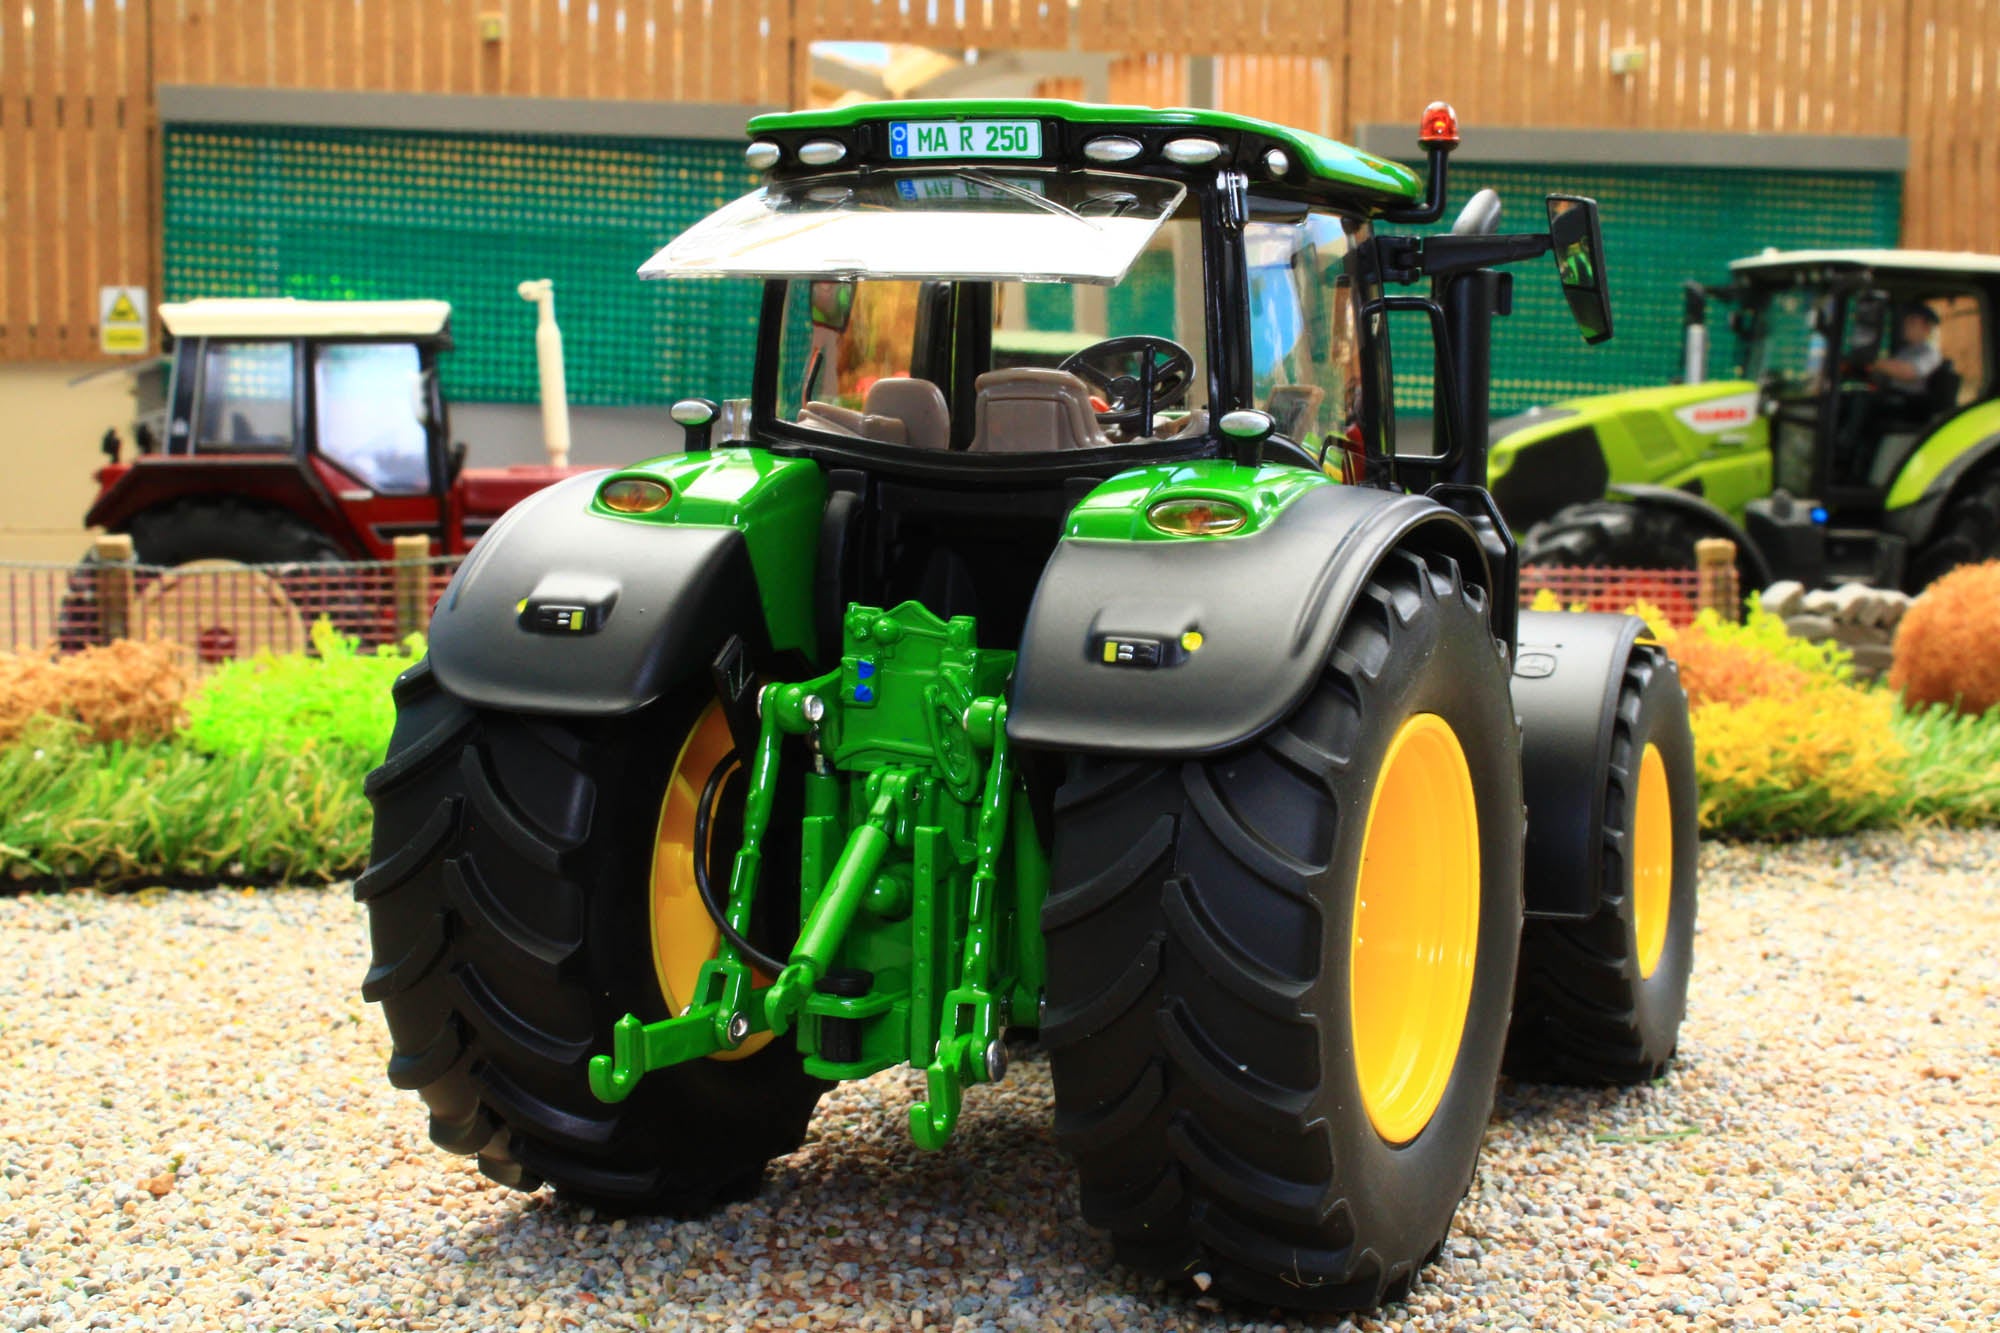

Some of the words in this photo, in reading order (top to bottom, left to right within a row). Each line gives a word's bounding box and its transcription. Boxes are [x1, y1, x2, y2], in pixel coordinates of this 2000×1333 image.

[917, 126, 949, 152] MA
[959, 126, 974, 152] R
[985, 126, 1028, 152] 250
[895, 145, 903, 155] D
